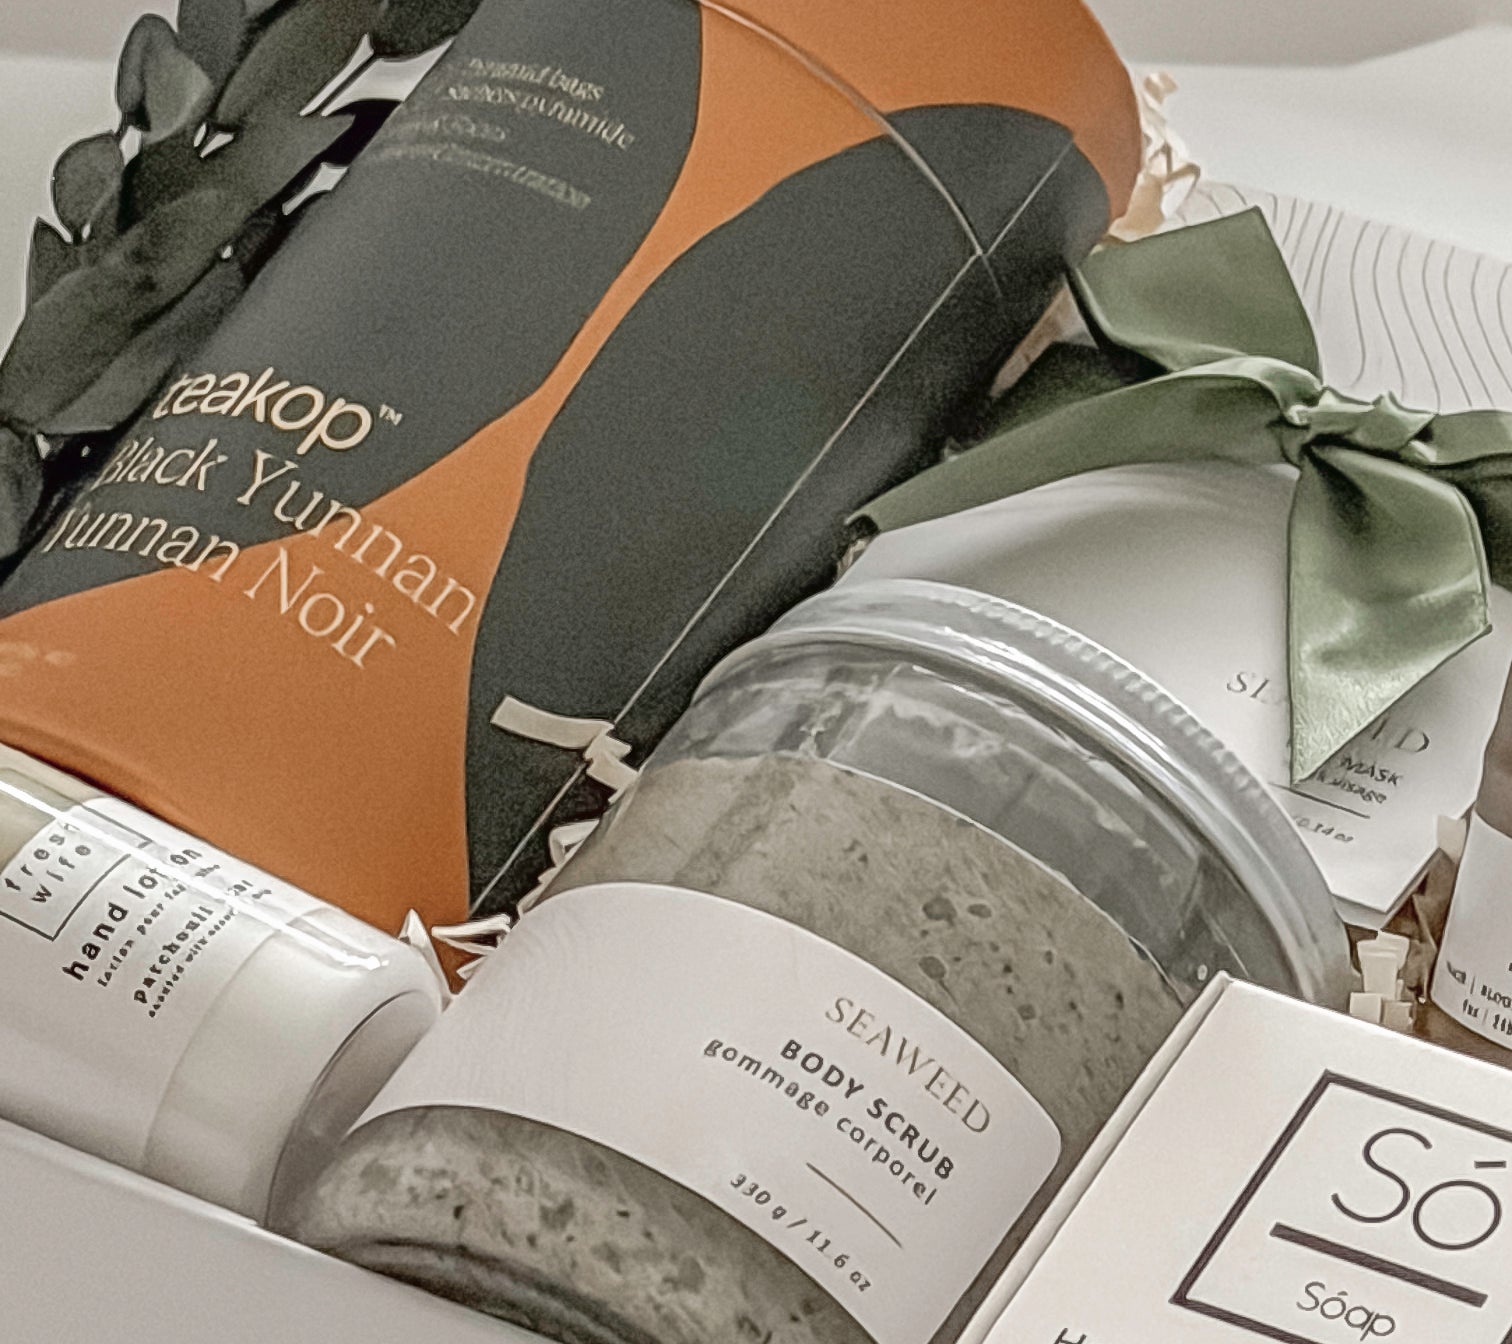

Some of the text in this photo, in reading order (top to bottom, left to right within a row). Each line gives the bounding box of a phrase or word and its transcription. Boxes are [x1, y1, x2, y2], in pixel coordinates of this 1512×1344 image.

[237, 449, 478, 636] Yunnan
[244, 546, 398, 670] Noir
[61, 846, 205, 983] hand loton
[703, 1037, 938, 1206] gommage corporel
[780, 1038, 956, 1181] BODY SCRUB
[824, 996, 992, 1135] SEAWEED
